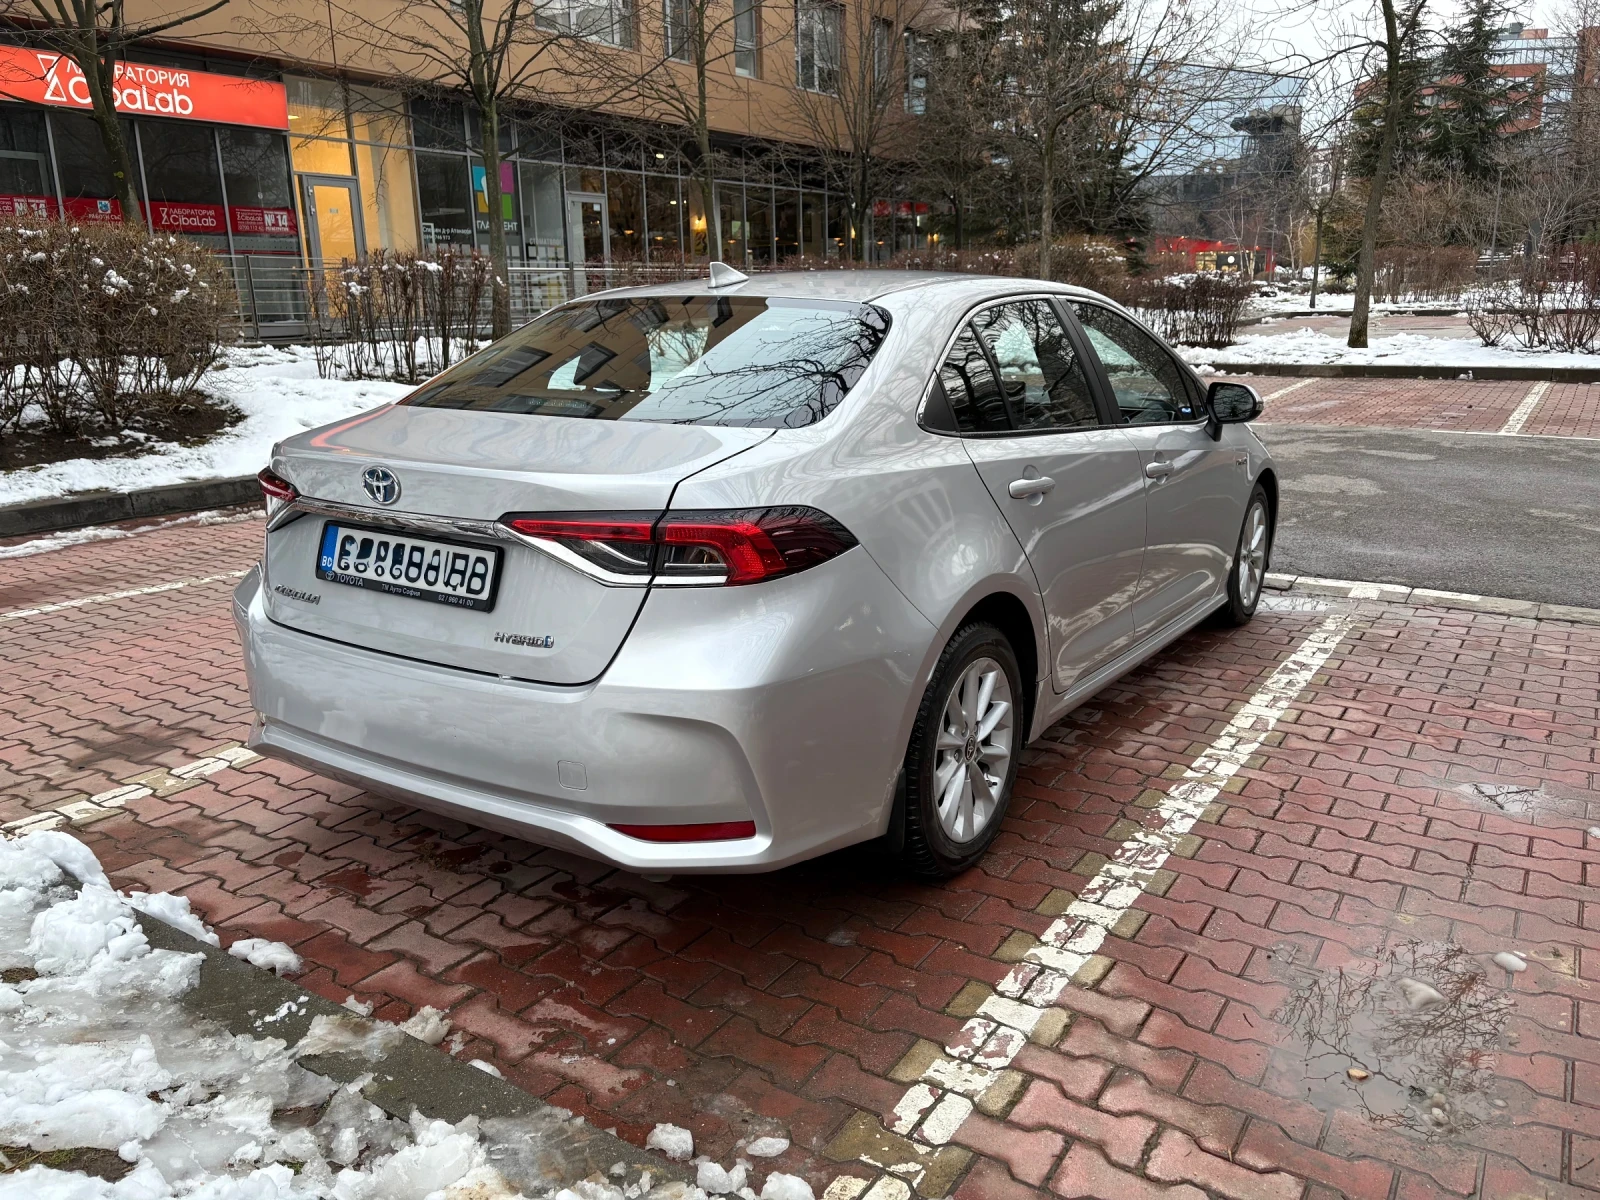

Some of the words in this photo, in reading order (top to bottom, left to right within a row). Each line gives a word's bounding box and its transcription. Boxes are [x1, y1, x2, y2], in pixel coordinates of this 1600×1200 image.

[67, 59, 190, 88] ЛРАТОРИЯ
[68, 76, 193, 115] CaLab
[169, 208, 216, 217] ЛАБОРАТОРИЯ
[169, 214, 217, 227] CibaLab
[276, 214, 288, 228] 14
[336, 573, 364, 587] TOYOTA
[402, 587, 421, 597] София
[493, 631, 544, 648] HYBRID
